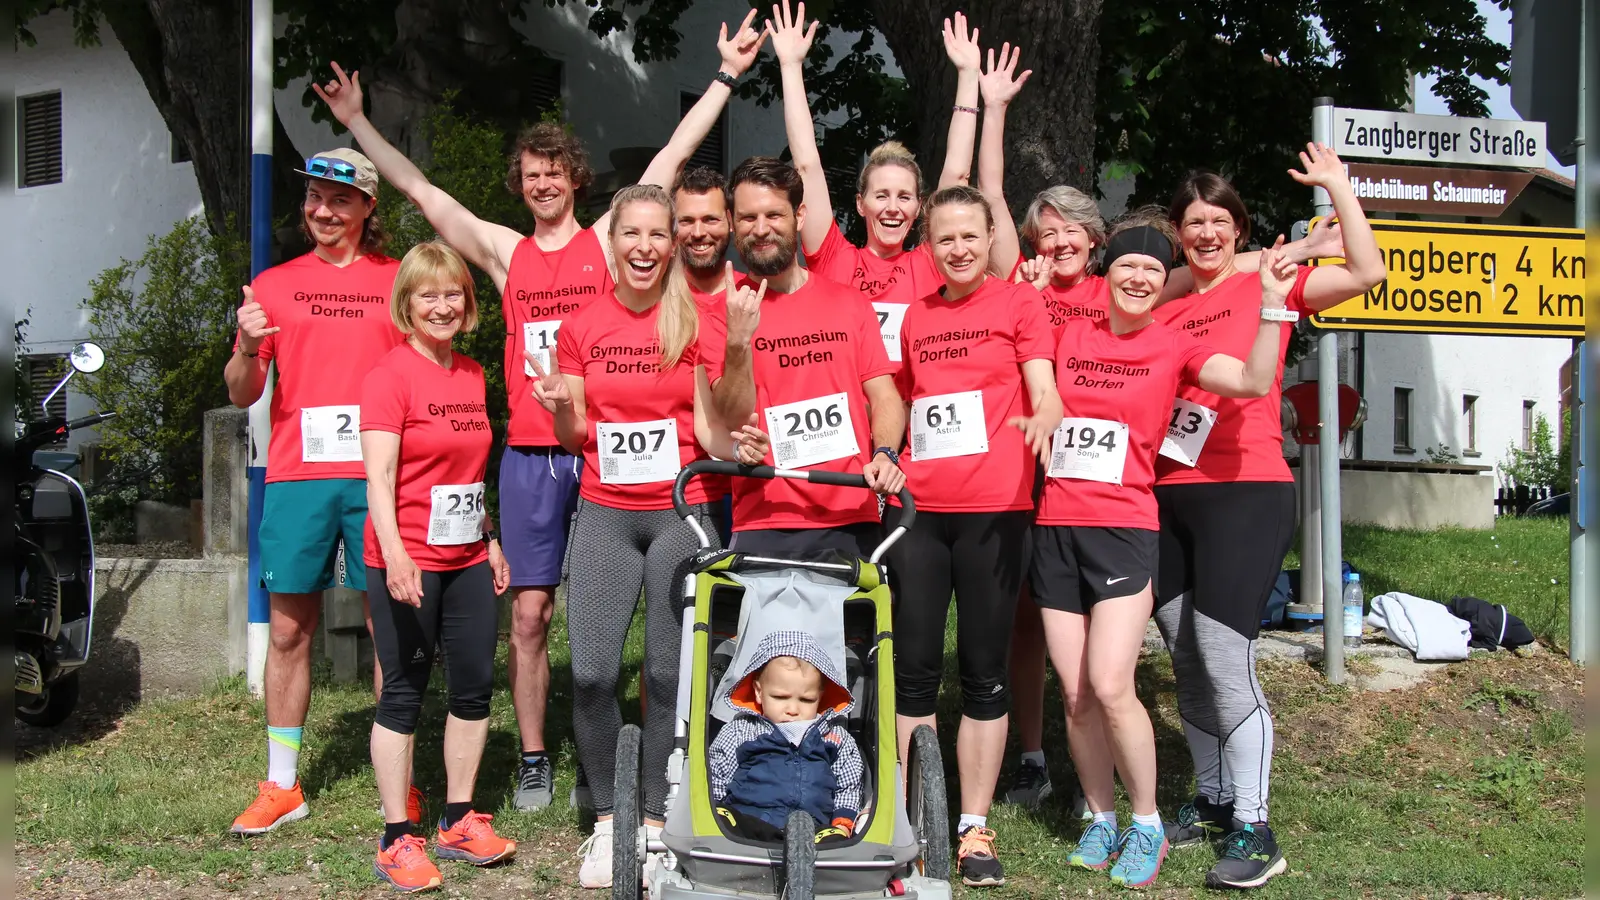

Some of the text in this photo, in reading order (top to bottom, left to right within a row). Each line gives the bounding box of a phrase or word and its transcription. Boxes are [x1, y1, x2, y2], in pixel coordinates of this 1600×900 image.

[1344, 118, 1536, 158] Zangberger Straße
[1350, 175, 1507, 205] Hebebühnen Schaumeier
[1378, 241, 1497, 284] ngberg
[1516, 245, 1533, 277] 4
[293, 291, 385, 304] Gymnasium
[516, 284, 597, 304] Gymnasium
[1364, 279, 1584, 318] Moosen 2 km
[310, 304, 364, 318] Dorfen
[754, 329, 848, 353] Gymnasium
[912, 328, 990, 353] Gymnasium
[778, 350, 834, 368] Dorfen
[919, 347, 969, 364] Dorfen
[1066, 357, 1150, 377] Gymnasium
[1073, 375, 1125, 390] Dorfen
[336, 413, 353, 434] 2
[450, 418, 489, 431] Dorfen
[784, 403, 843, 437] 206
[926, 402, 962, 428] 61
[801, 428, 839, 442] Christian
[936, 426, 961, 435] Astrid
[1064, 426, 1117, 453] 194
[610, 429, 666, 454] 207
[632, 453, 653, 462] Julia
[1076, 448, 1100, 459] Sonja
[446, 490, 483, 516] 236
